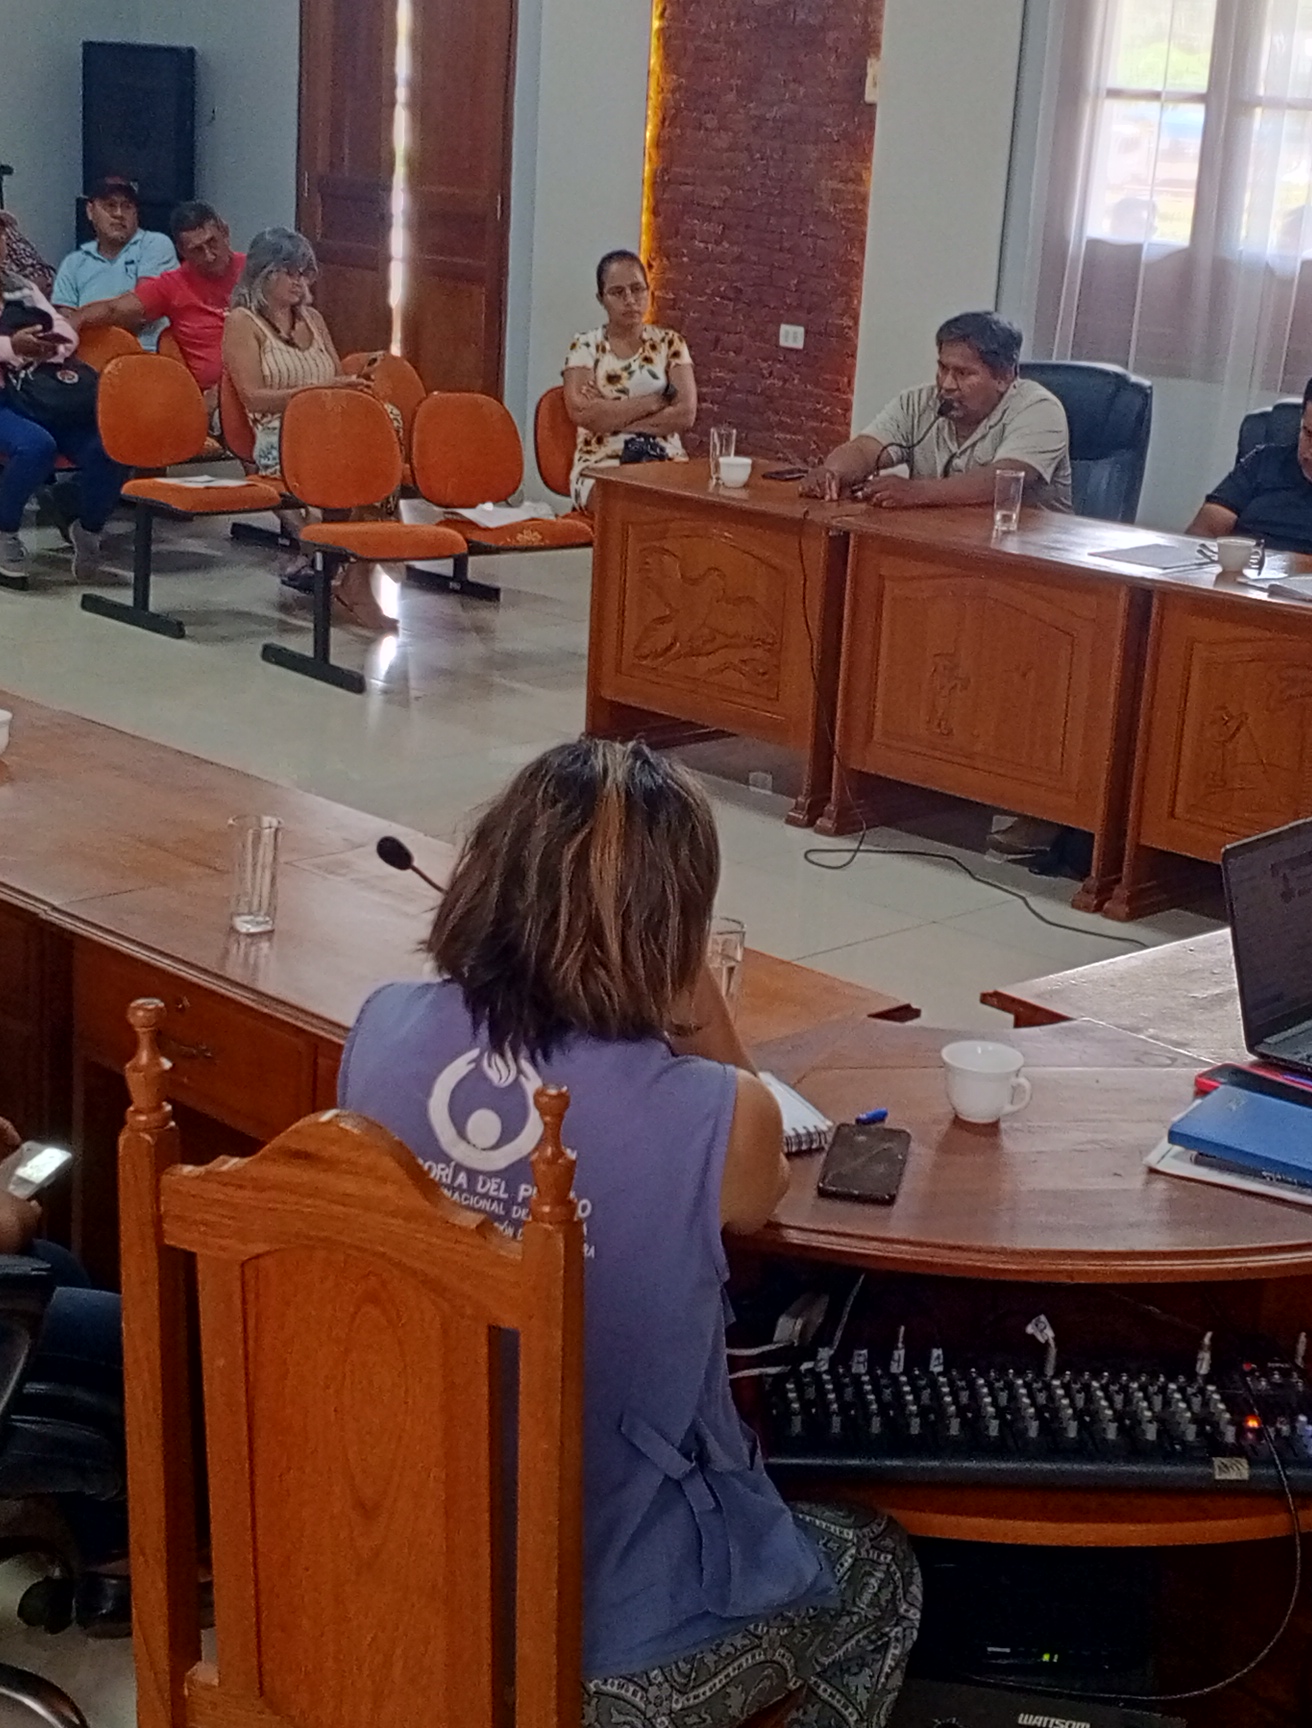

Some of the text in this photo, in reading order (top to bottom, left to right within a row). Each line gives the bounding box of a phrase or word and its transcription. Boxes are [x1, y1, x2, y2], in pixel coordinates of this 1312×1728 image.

[417, 1156, 509, 1199] ORÍA DEL
[440, 1185, 506, 1216] NACIONAL
